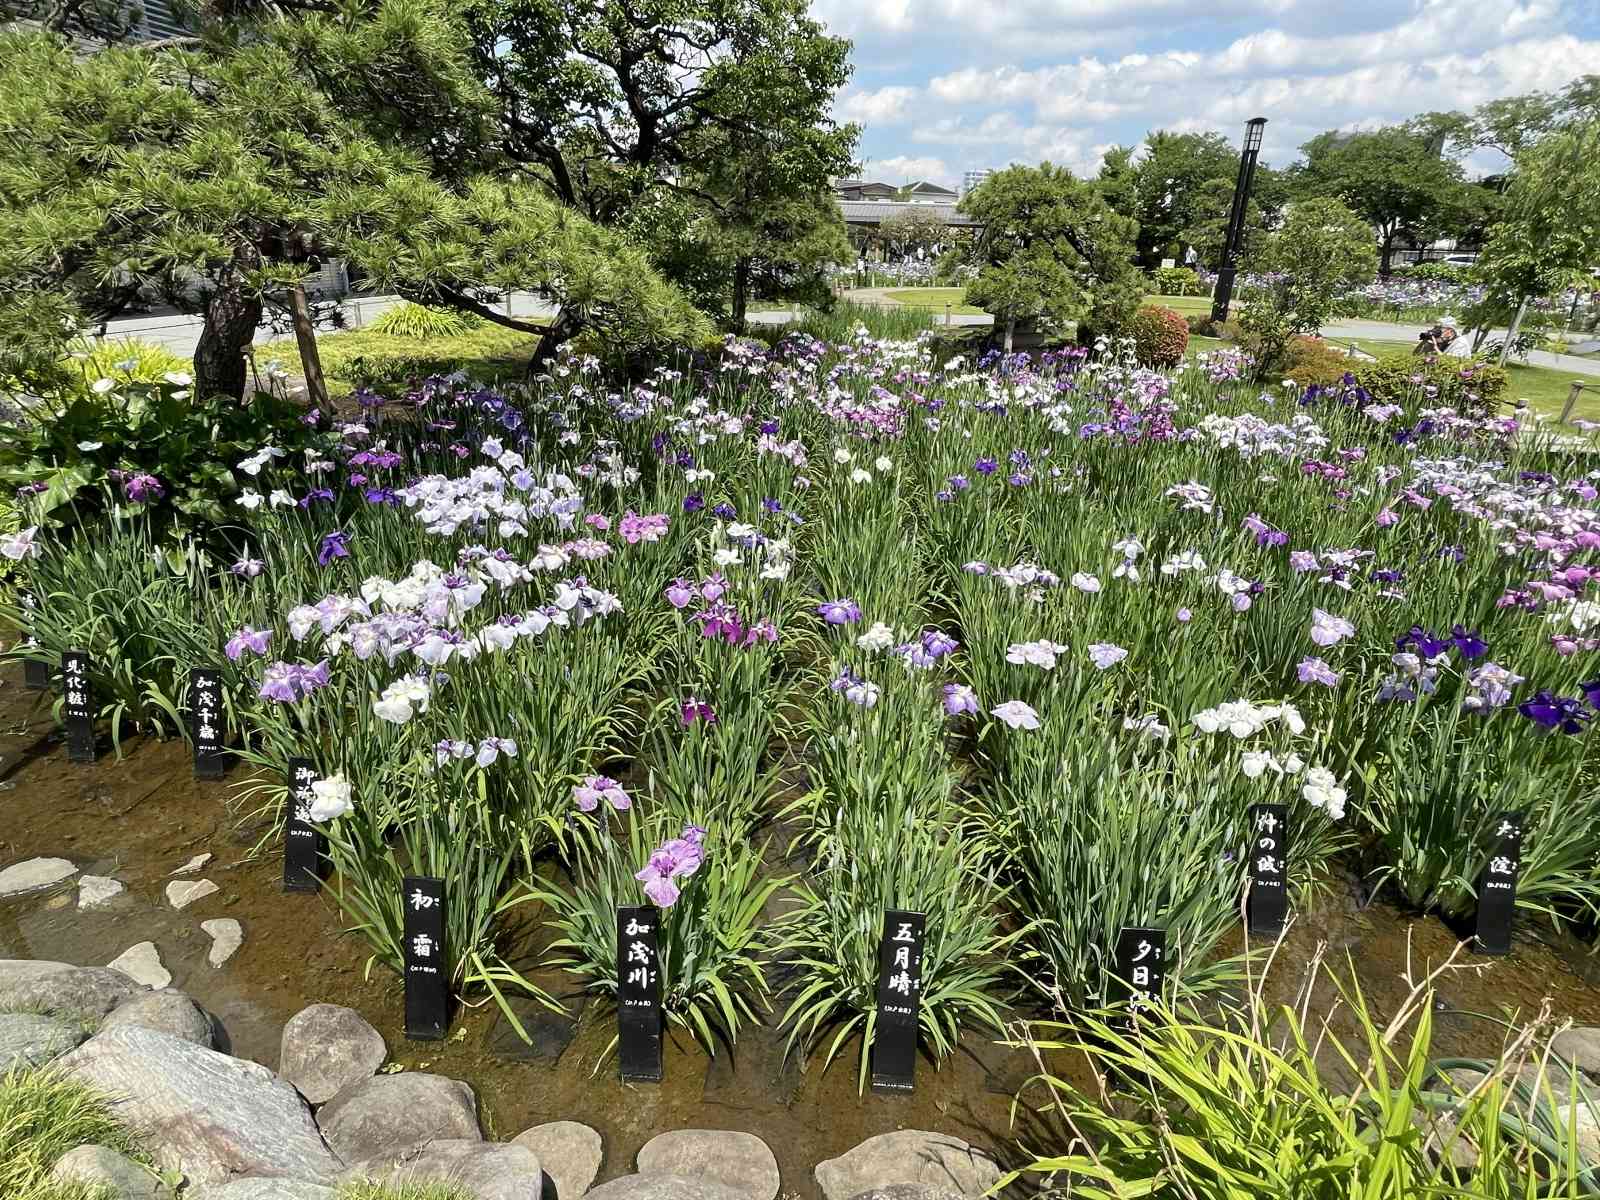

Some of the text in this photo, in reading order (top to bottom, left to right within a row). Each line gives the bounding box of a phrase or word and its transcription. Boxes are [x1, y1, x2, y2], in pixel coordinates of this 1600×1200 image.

[197, 676, 215, 740] 加茂千歳
[410, 888, 434, 957] 初霜
[625, 918, 650, 990] 加茂川
[888, 922, 915, 996] 五月晴
